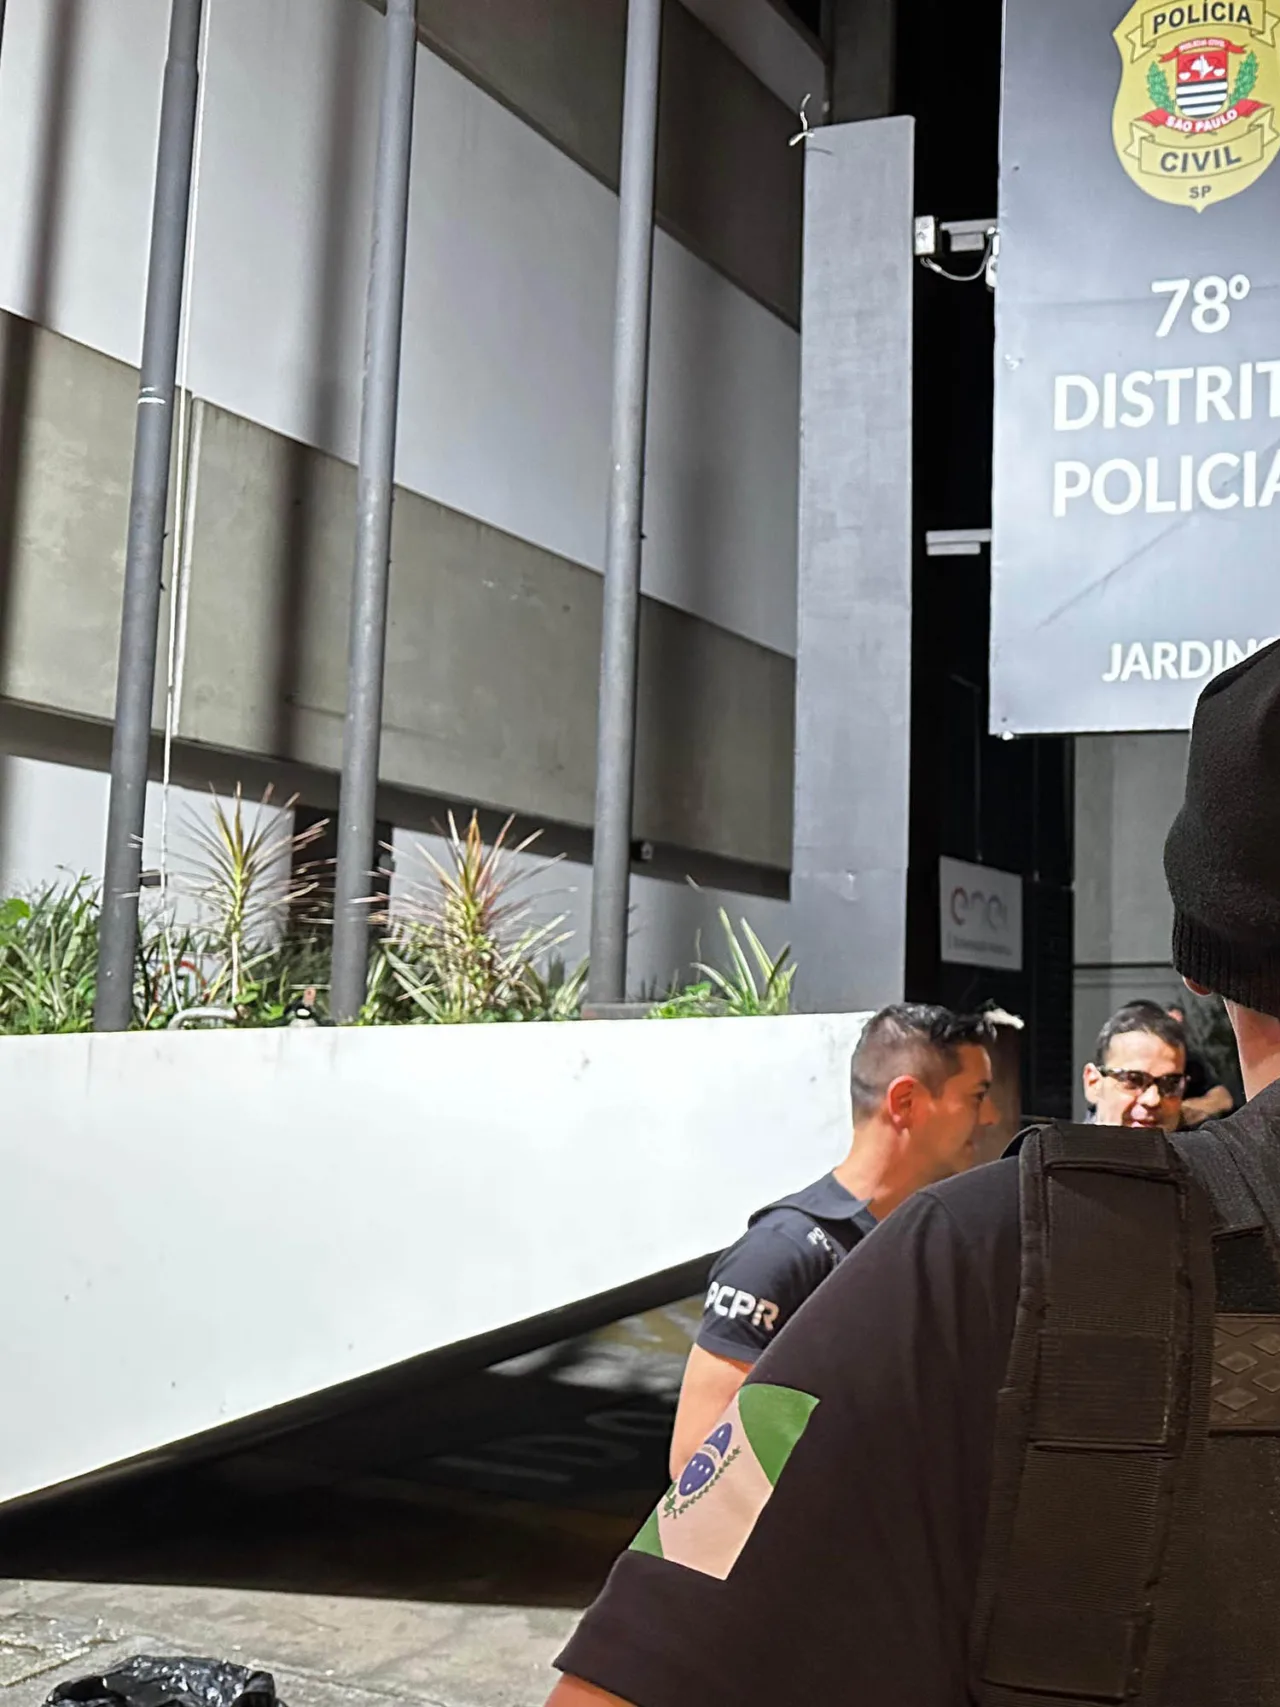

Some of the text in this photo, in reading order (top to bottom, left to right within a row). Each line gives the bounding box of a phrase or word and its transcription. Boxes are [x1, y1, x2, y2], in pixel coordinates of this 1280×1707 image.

[1195, 108, 1238, 132] PAULO
[1160, 146, 1242, 173] CIVIL
[1189, 185, 1212, 199] SP
[1101, 637, 1278, 682] JARDIN
